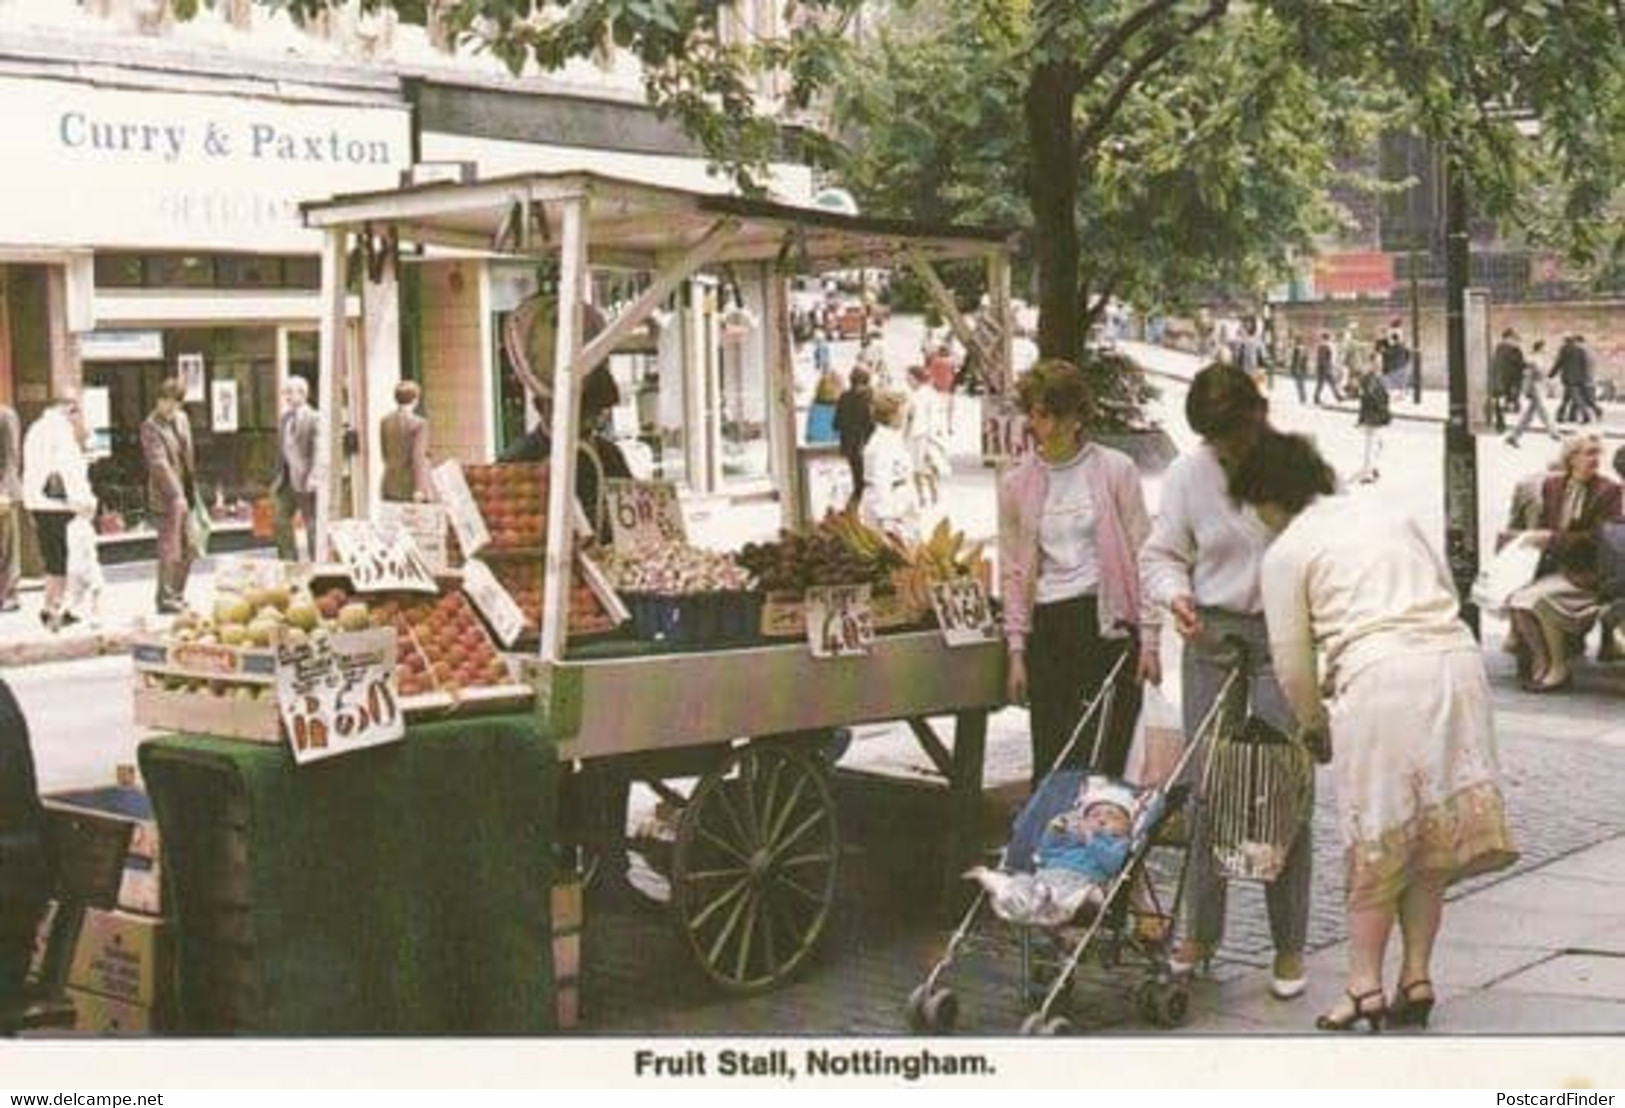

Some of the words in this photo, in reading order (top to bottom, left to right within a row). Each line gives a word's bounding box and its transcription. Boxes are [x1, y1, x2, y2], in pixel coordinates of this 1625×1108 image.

[59, 111, 187, 163] Curry
[204, 122, 232, 156] &
[252, 123, 392, 164] Paxton
